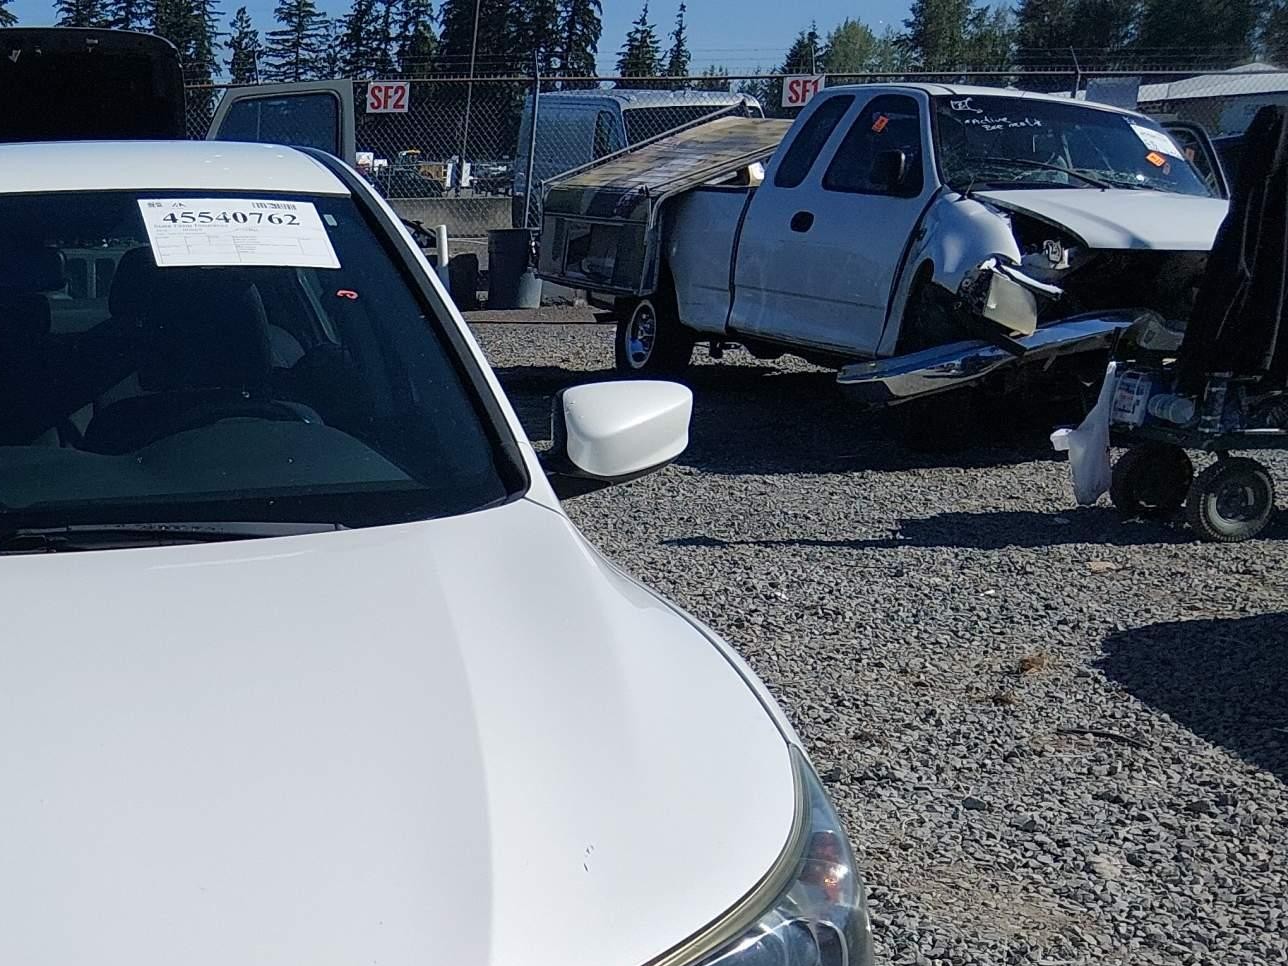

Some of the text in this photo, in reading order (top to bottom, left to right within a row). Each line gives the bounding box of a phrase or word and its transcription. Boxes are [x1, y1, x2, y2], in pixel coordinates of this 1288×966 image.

[370, 85, 406, 110] SF2
[788, 80, 819, 103] SF1
[162, 211, 300, 226] 45540762
